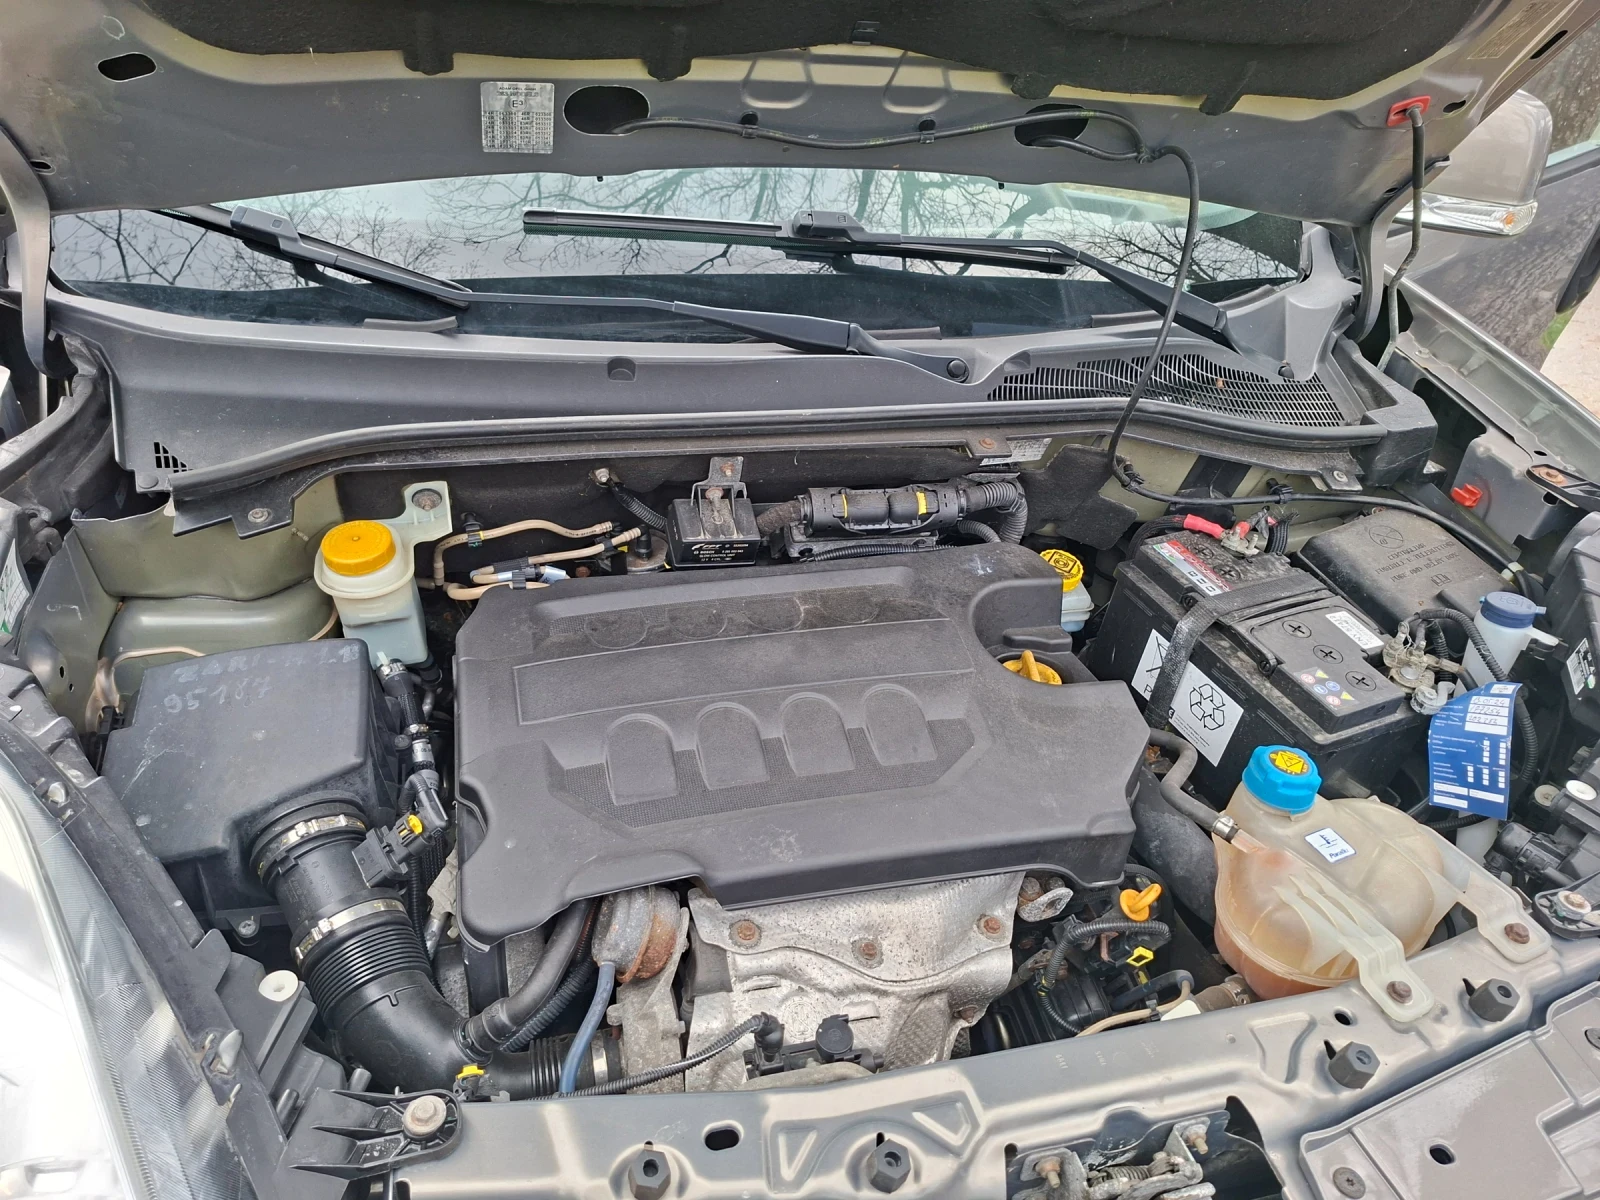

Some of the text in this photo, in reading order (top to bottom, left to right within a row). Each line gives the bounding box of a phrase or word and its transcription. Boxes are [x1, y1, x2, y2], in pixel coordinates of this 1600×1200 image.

[512, 100, 524, 108] E3
[1390, 571, 1407, 583] FUSE
[1409, 566, 1423, 575] AND
[1423, 557, 1445, 569] RELAY
